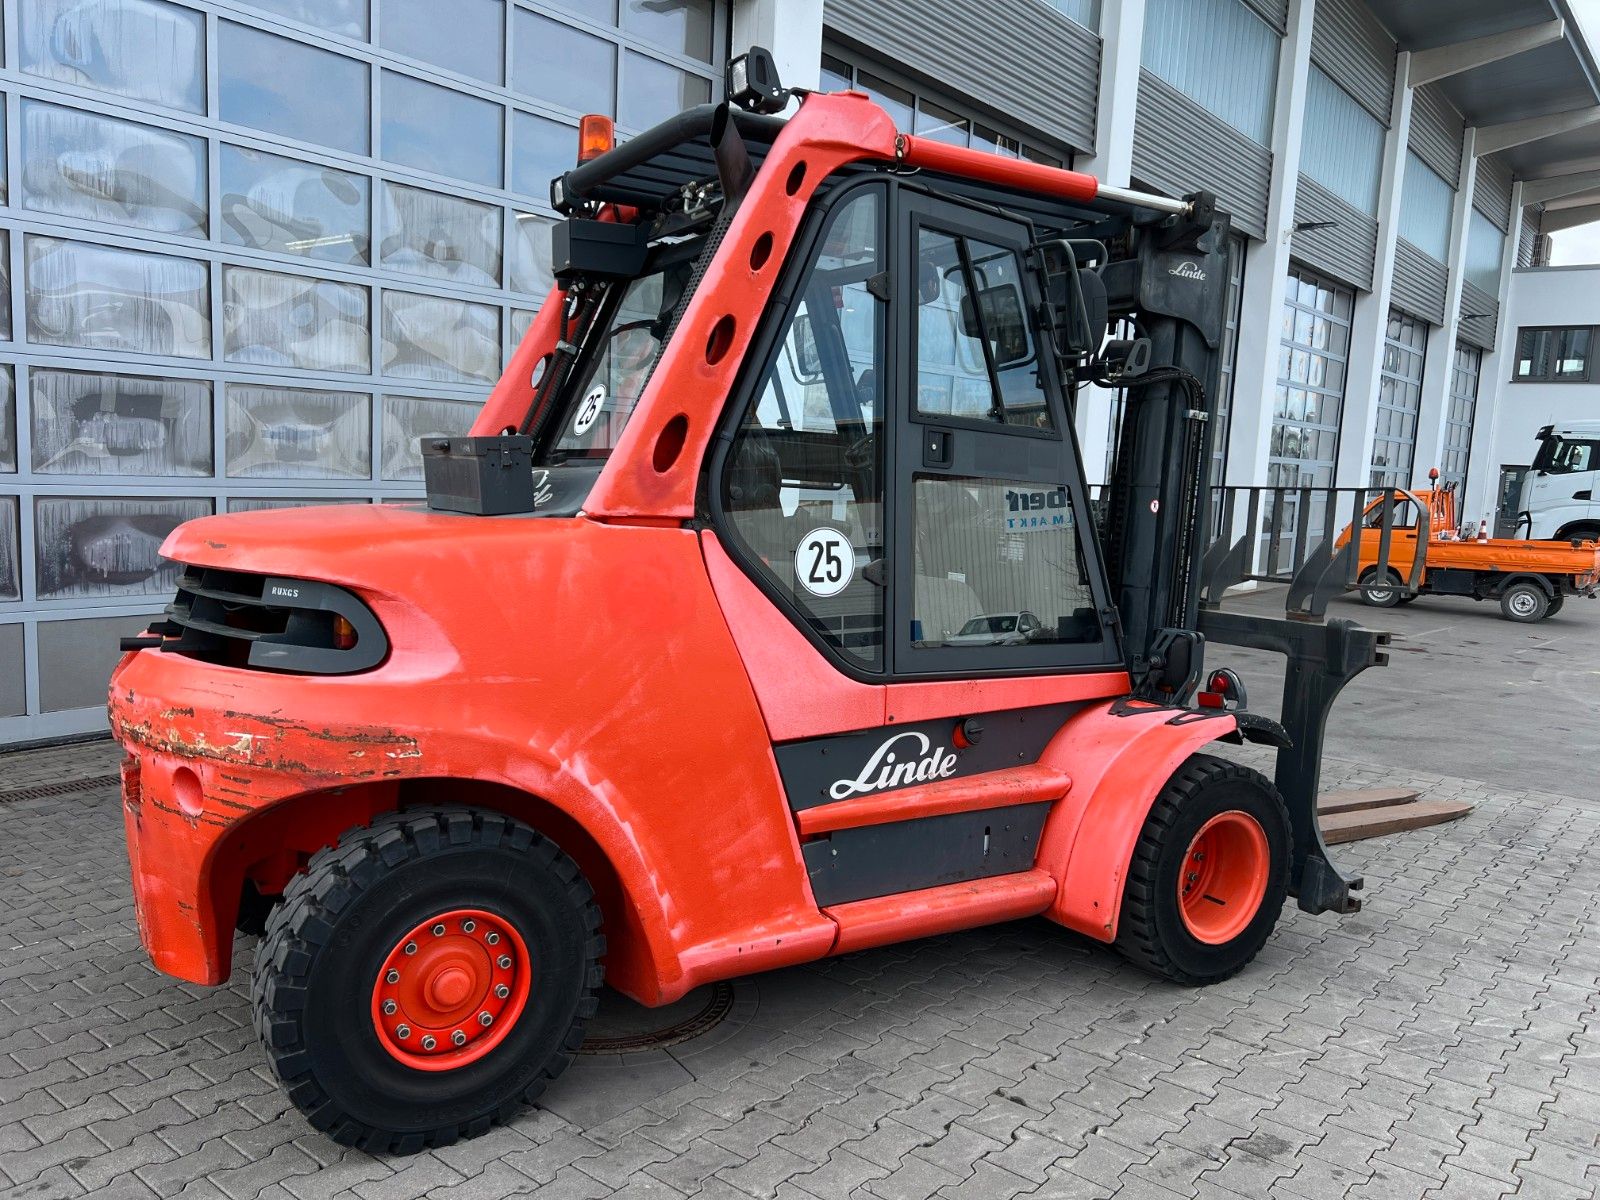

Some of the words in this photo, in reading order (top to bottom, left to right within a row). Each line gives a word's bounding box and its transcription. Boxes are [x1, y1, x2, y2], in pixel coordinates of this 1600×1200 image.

[1168, 261, 1206, 280] Linde
[577, 393, 602, 426] 25
[808, 540, 842, 583] 25
[829, 731, 957, 800] Linde
